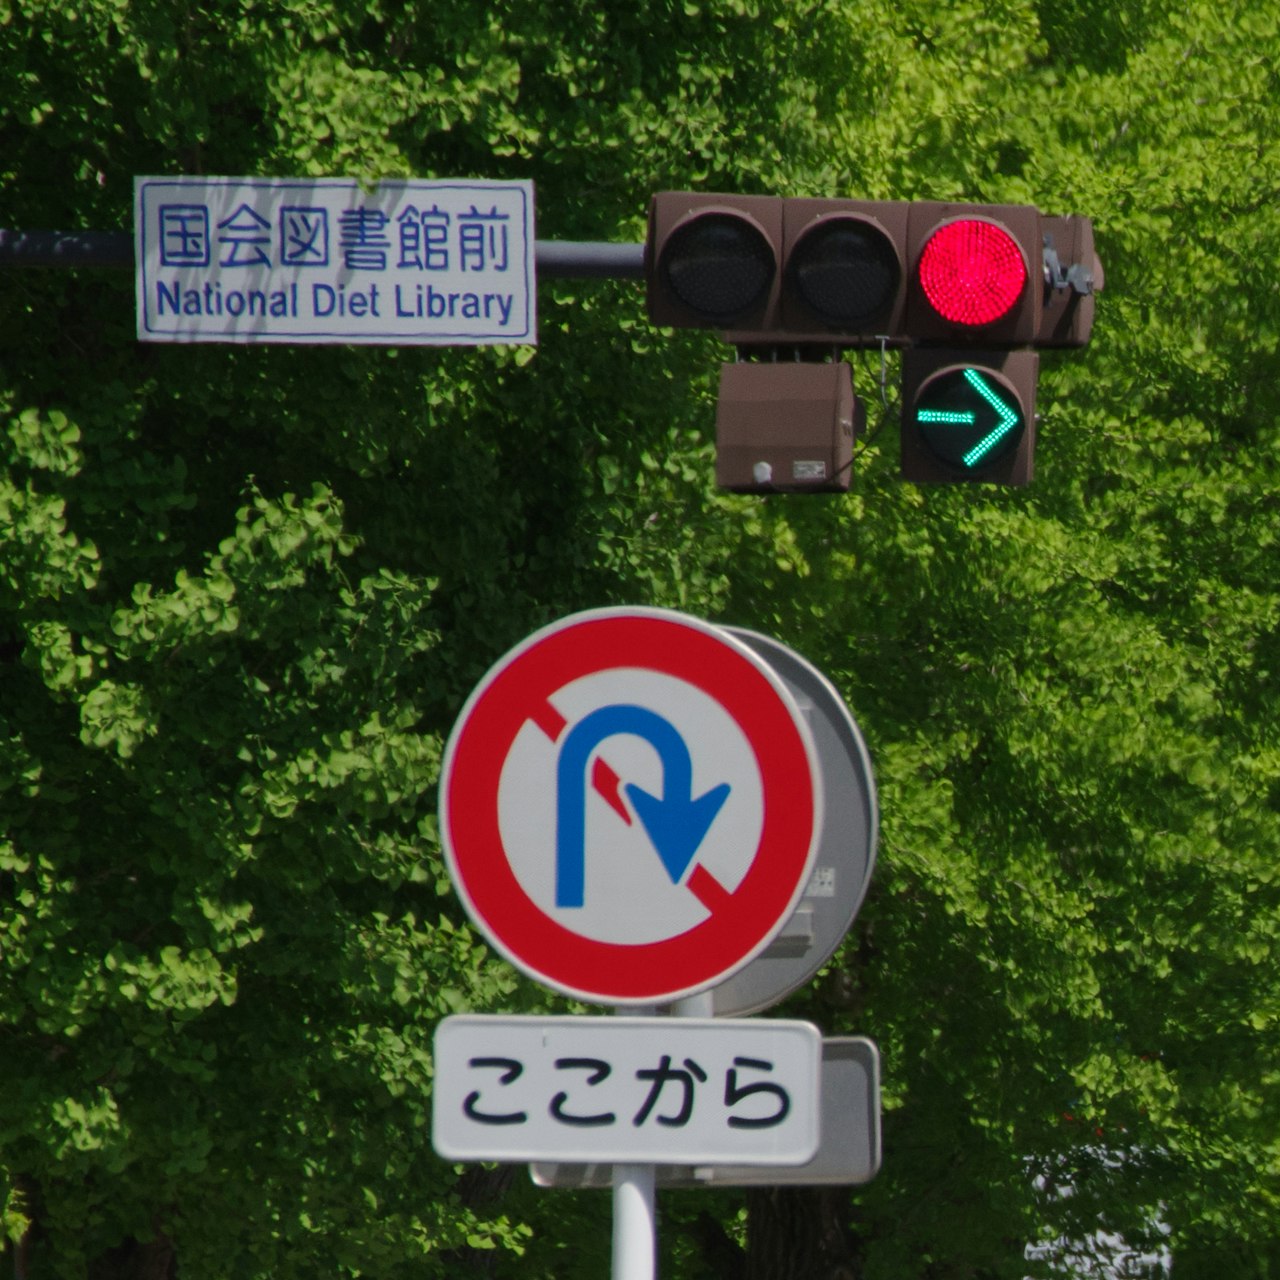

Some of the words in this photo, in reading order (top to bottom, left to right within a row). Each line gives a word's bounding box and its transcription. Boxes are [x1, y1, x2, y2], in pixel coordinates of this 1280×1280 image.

[159, 203, 511, 272] 国会図書館前
[157, 281, 298, 318] National
[312, 283, 380, 318] Diet
[395, 284, 513, 326] Library
[463, 1055, 790, 1129] ここから
